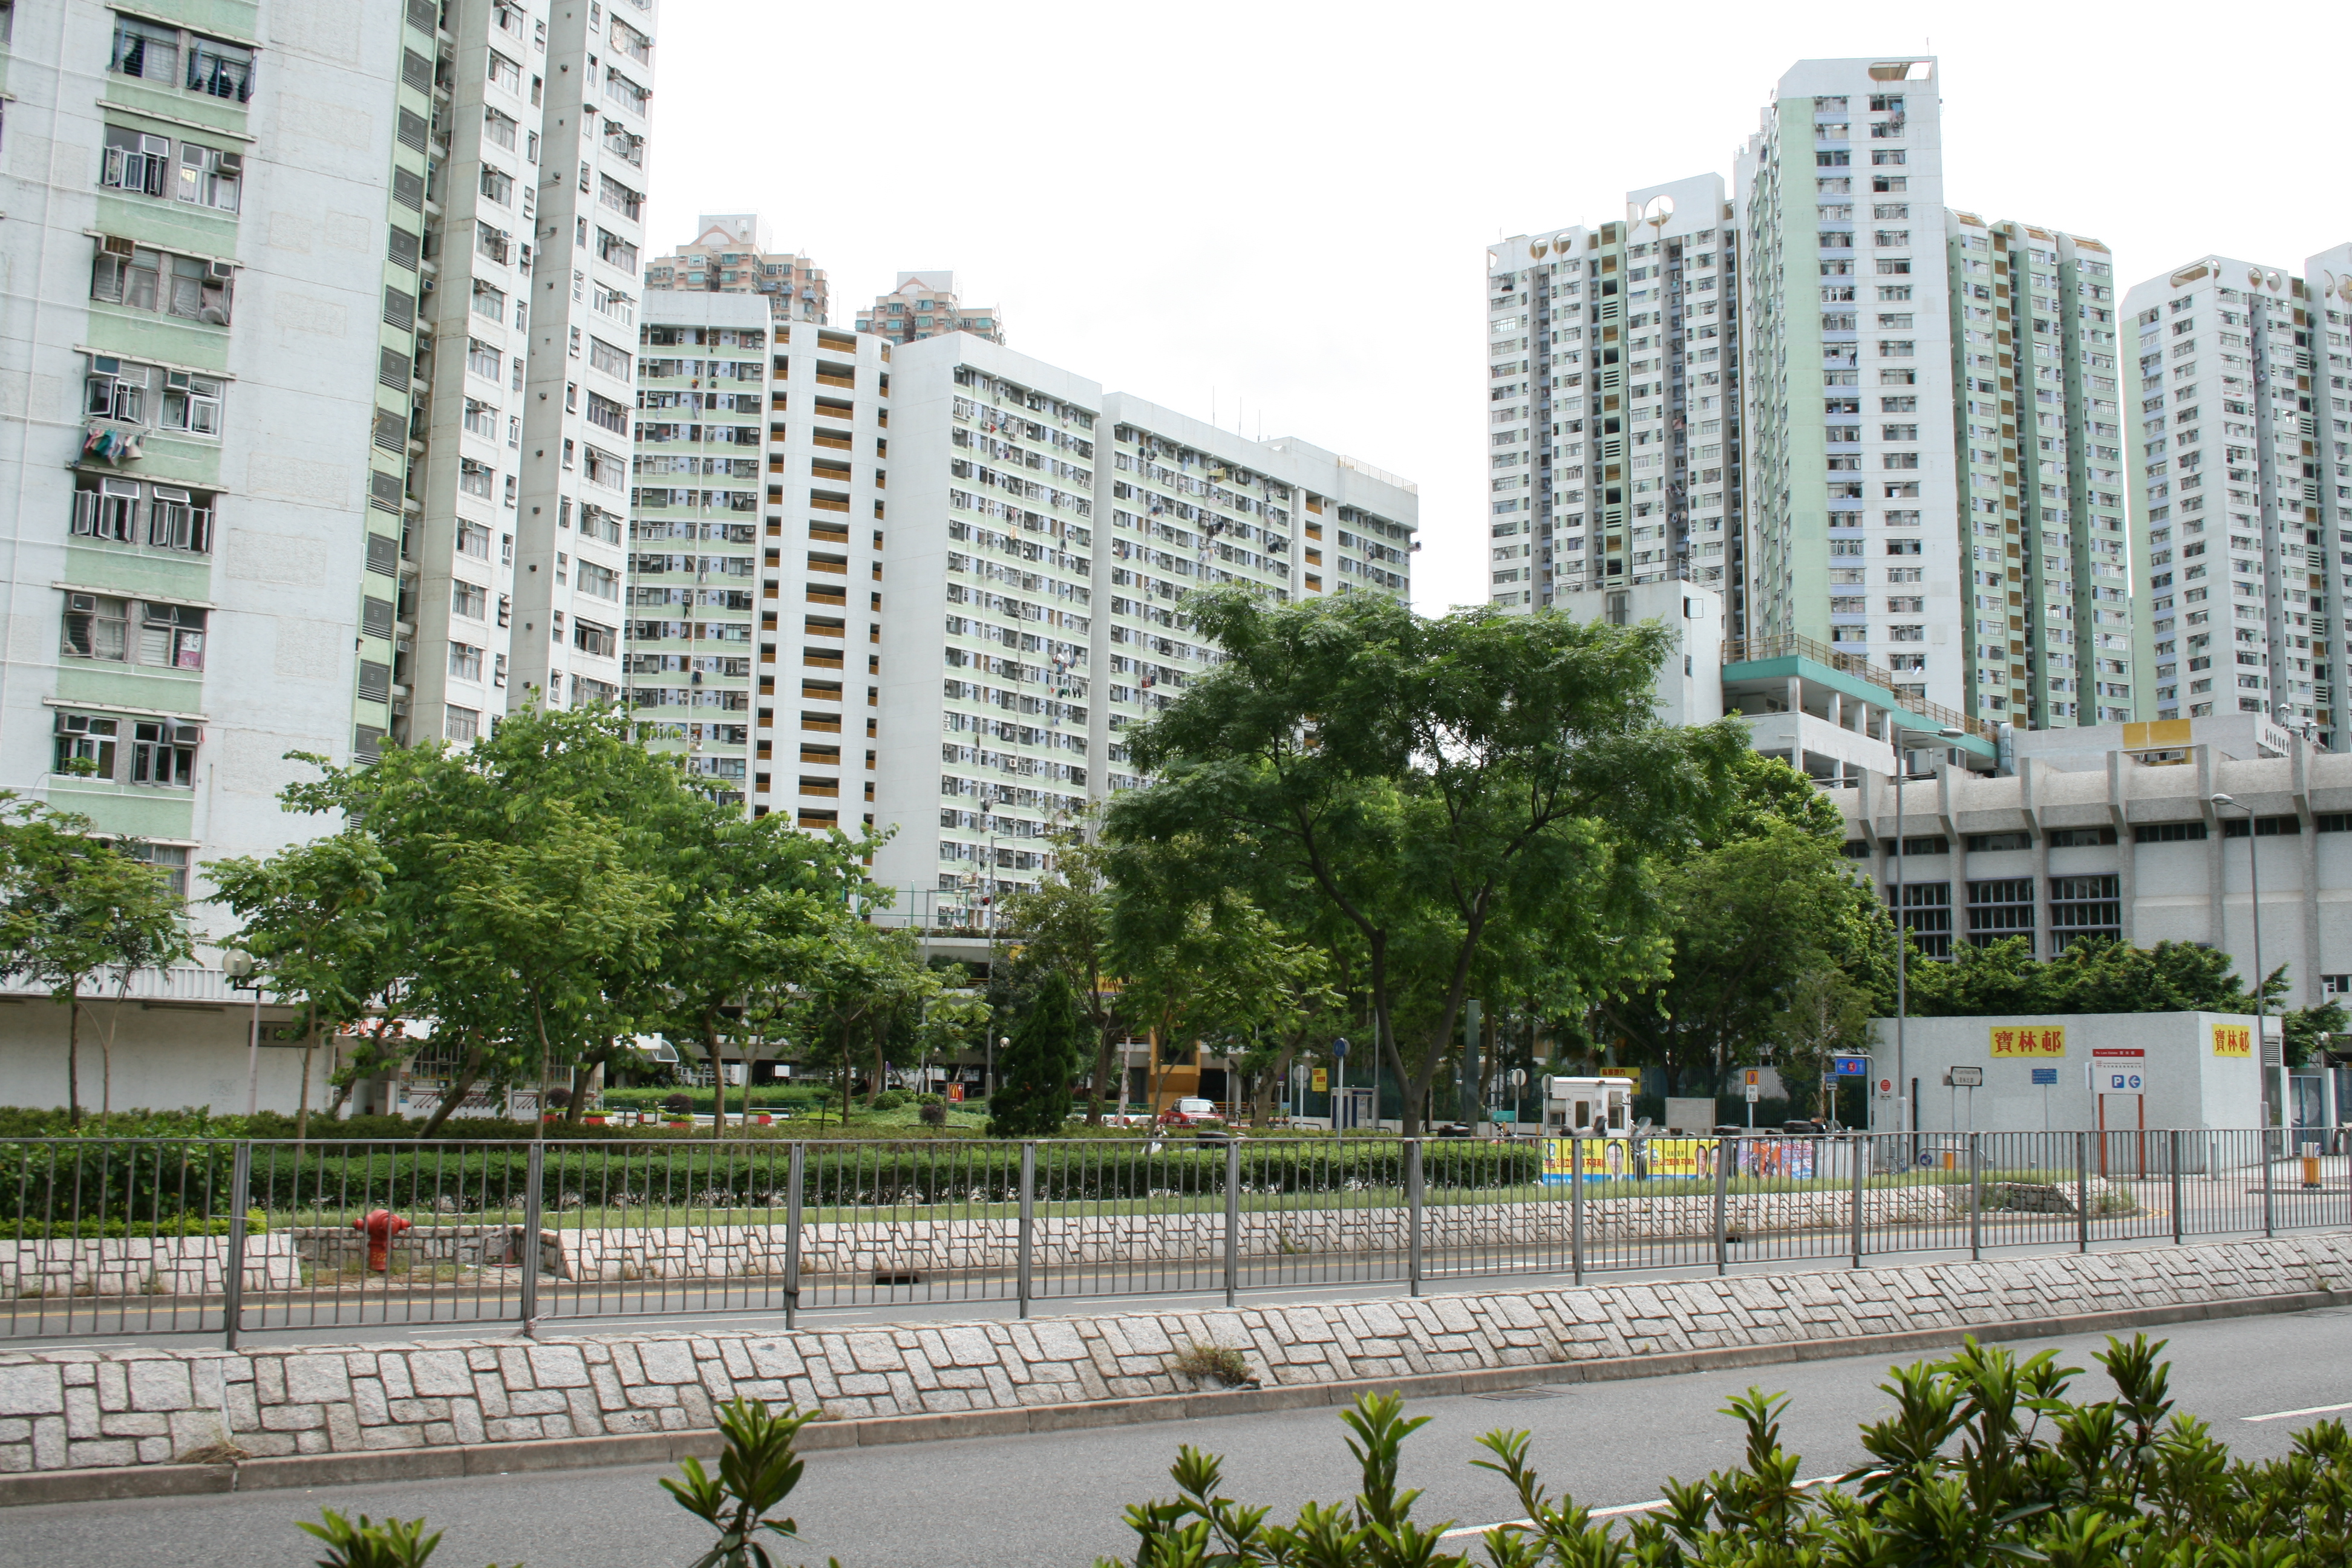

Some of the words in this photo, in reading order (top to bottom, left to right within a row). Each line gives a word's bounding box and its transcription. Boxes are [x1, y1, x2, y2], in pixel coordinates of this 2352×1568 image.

[1994, 1030, 2061, 1053] 寶林邨
[2215, 1028, 2249, 1052] 寶林邨
[2114, 1077, 2122, 1086] P
